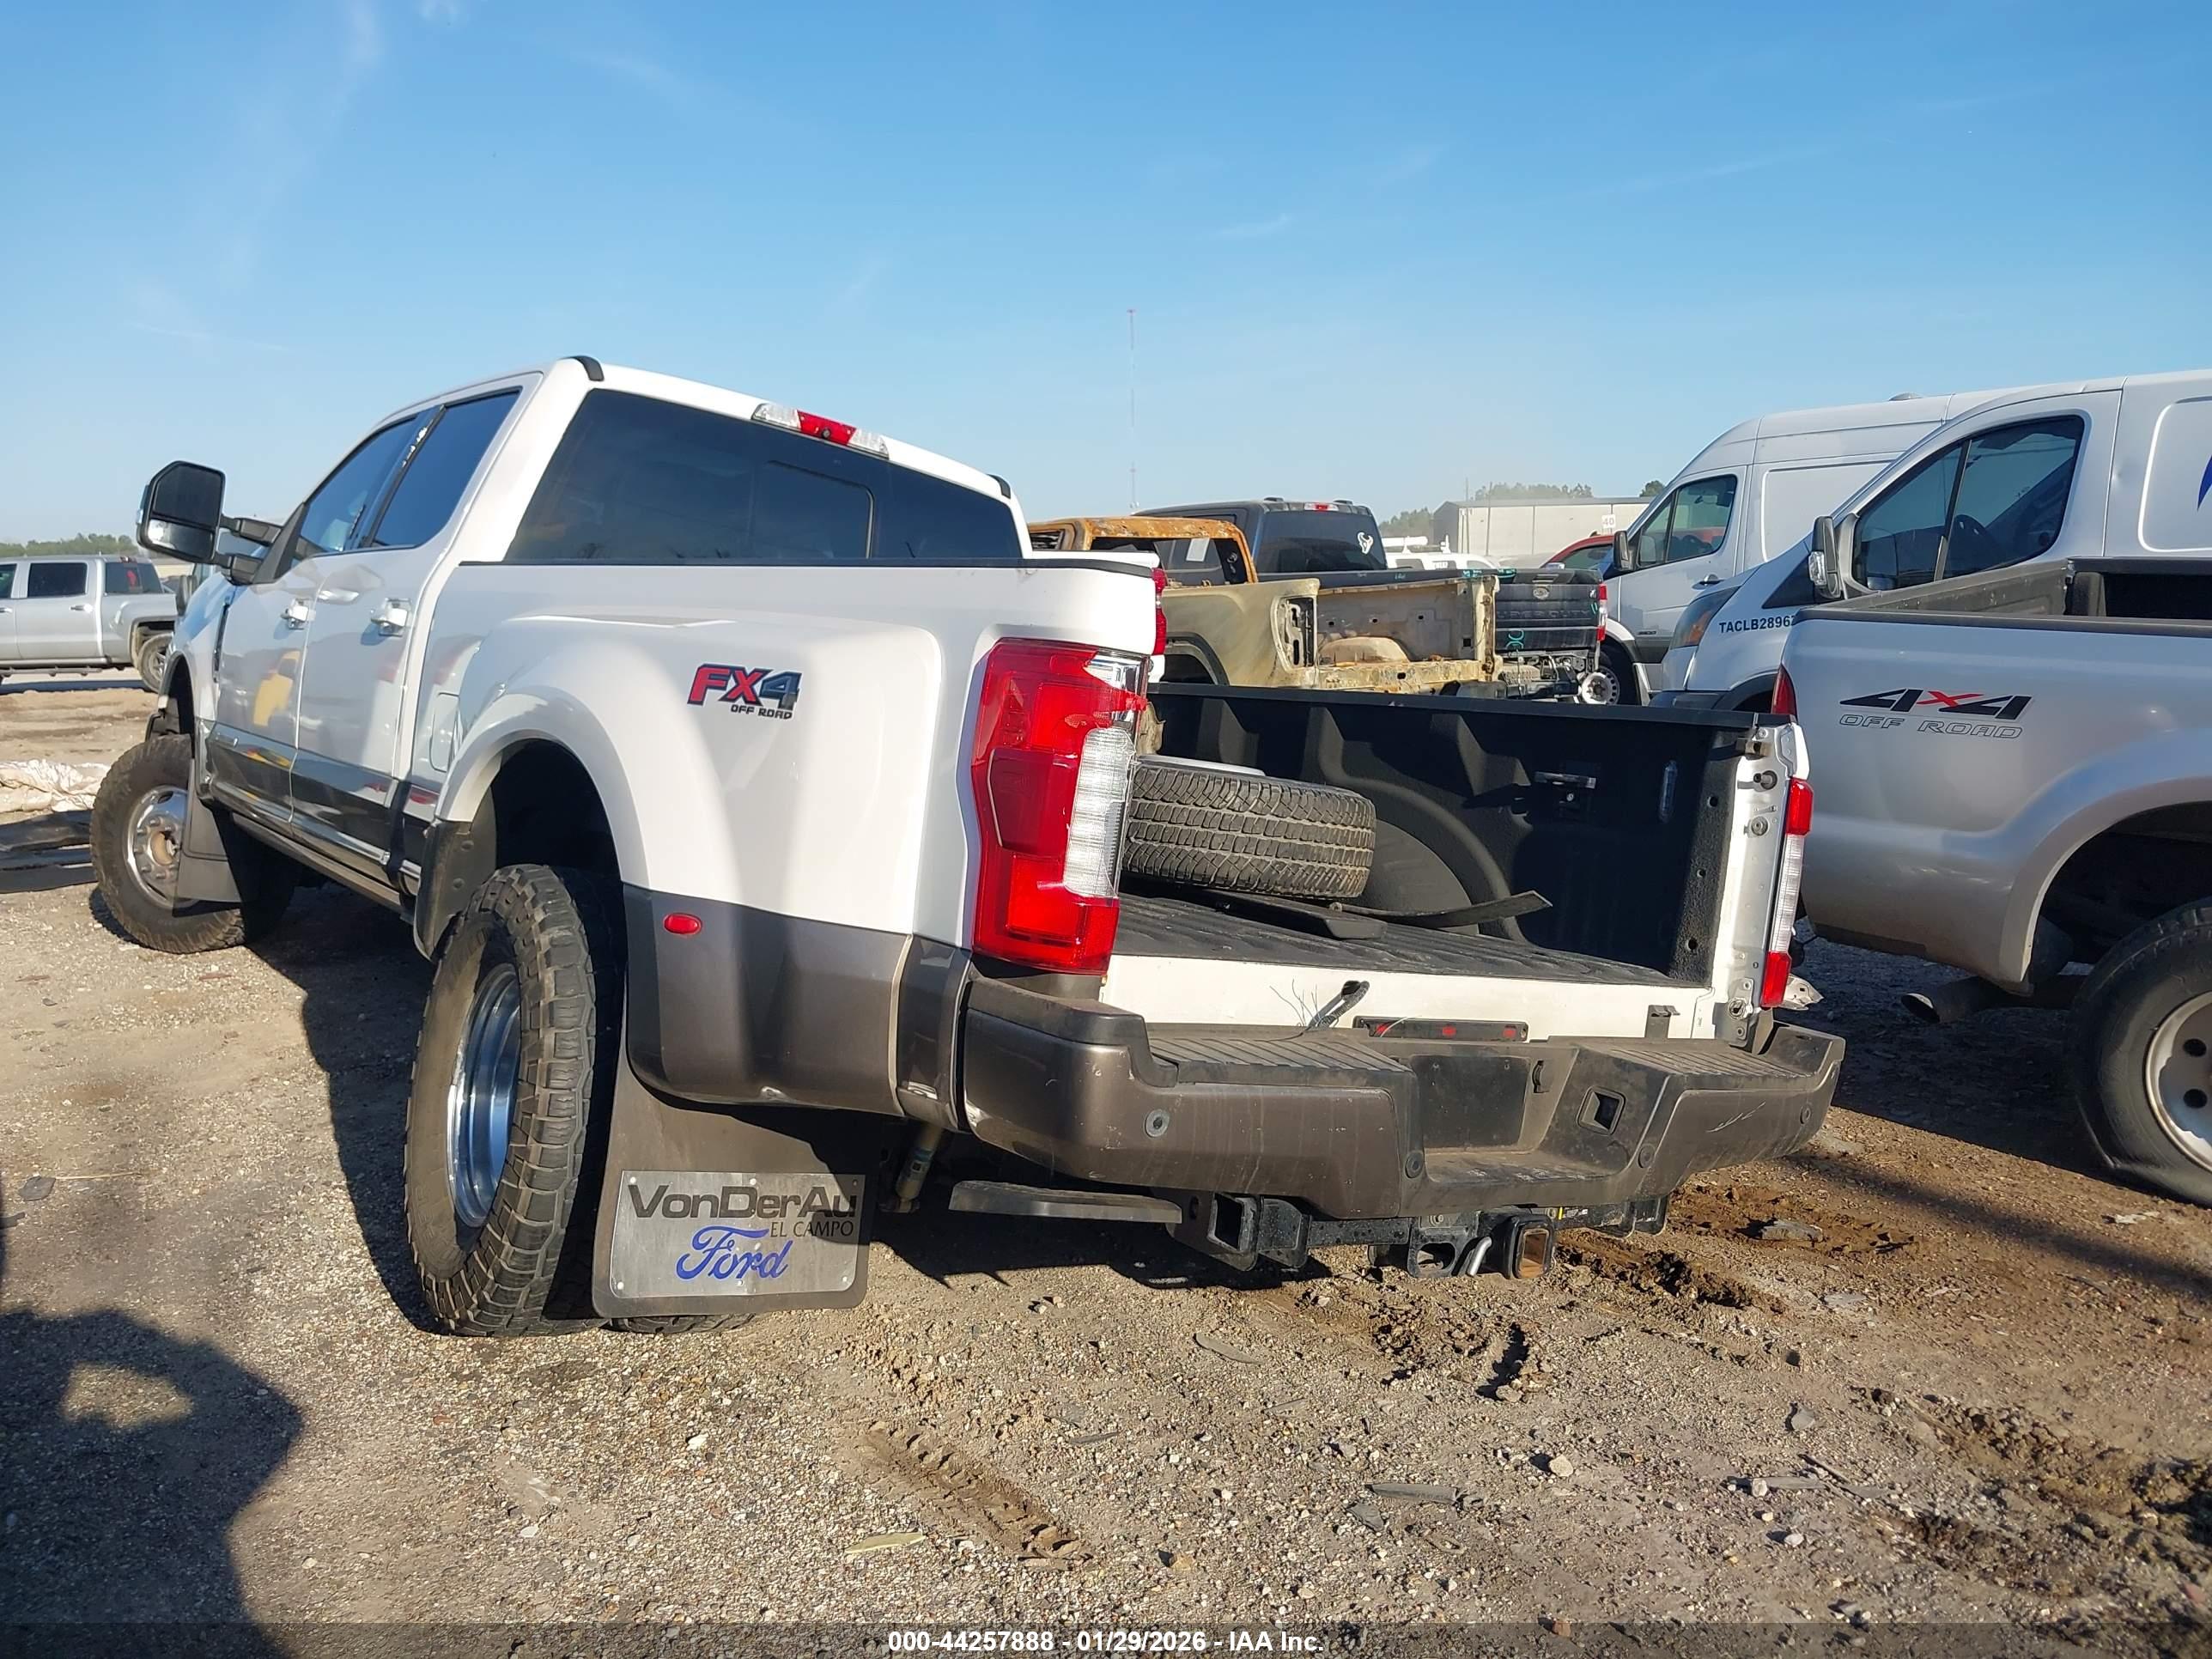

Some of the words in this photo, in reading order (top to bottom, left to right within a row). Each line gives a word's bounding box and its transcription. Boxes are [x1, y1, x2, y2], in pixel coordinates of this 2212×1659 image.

[687, 663, 803, 711] FX4
[731, 704, 755, 714] OFF
[757, 708, 793, 720] ROAD
[1839, 714, 1905, 729] OFF
[1917, 720, 2023, 739] ROAD
[628, 1184, 858, 1218] VonDerAu
[769, 1221, 787, 1237] EL
[793, 1220, 854, 1238] CAMPO
[676, 1225, 793, 1280] Ford
